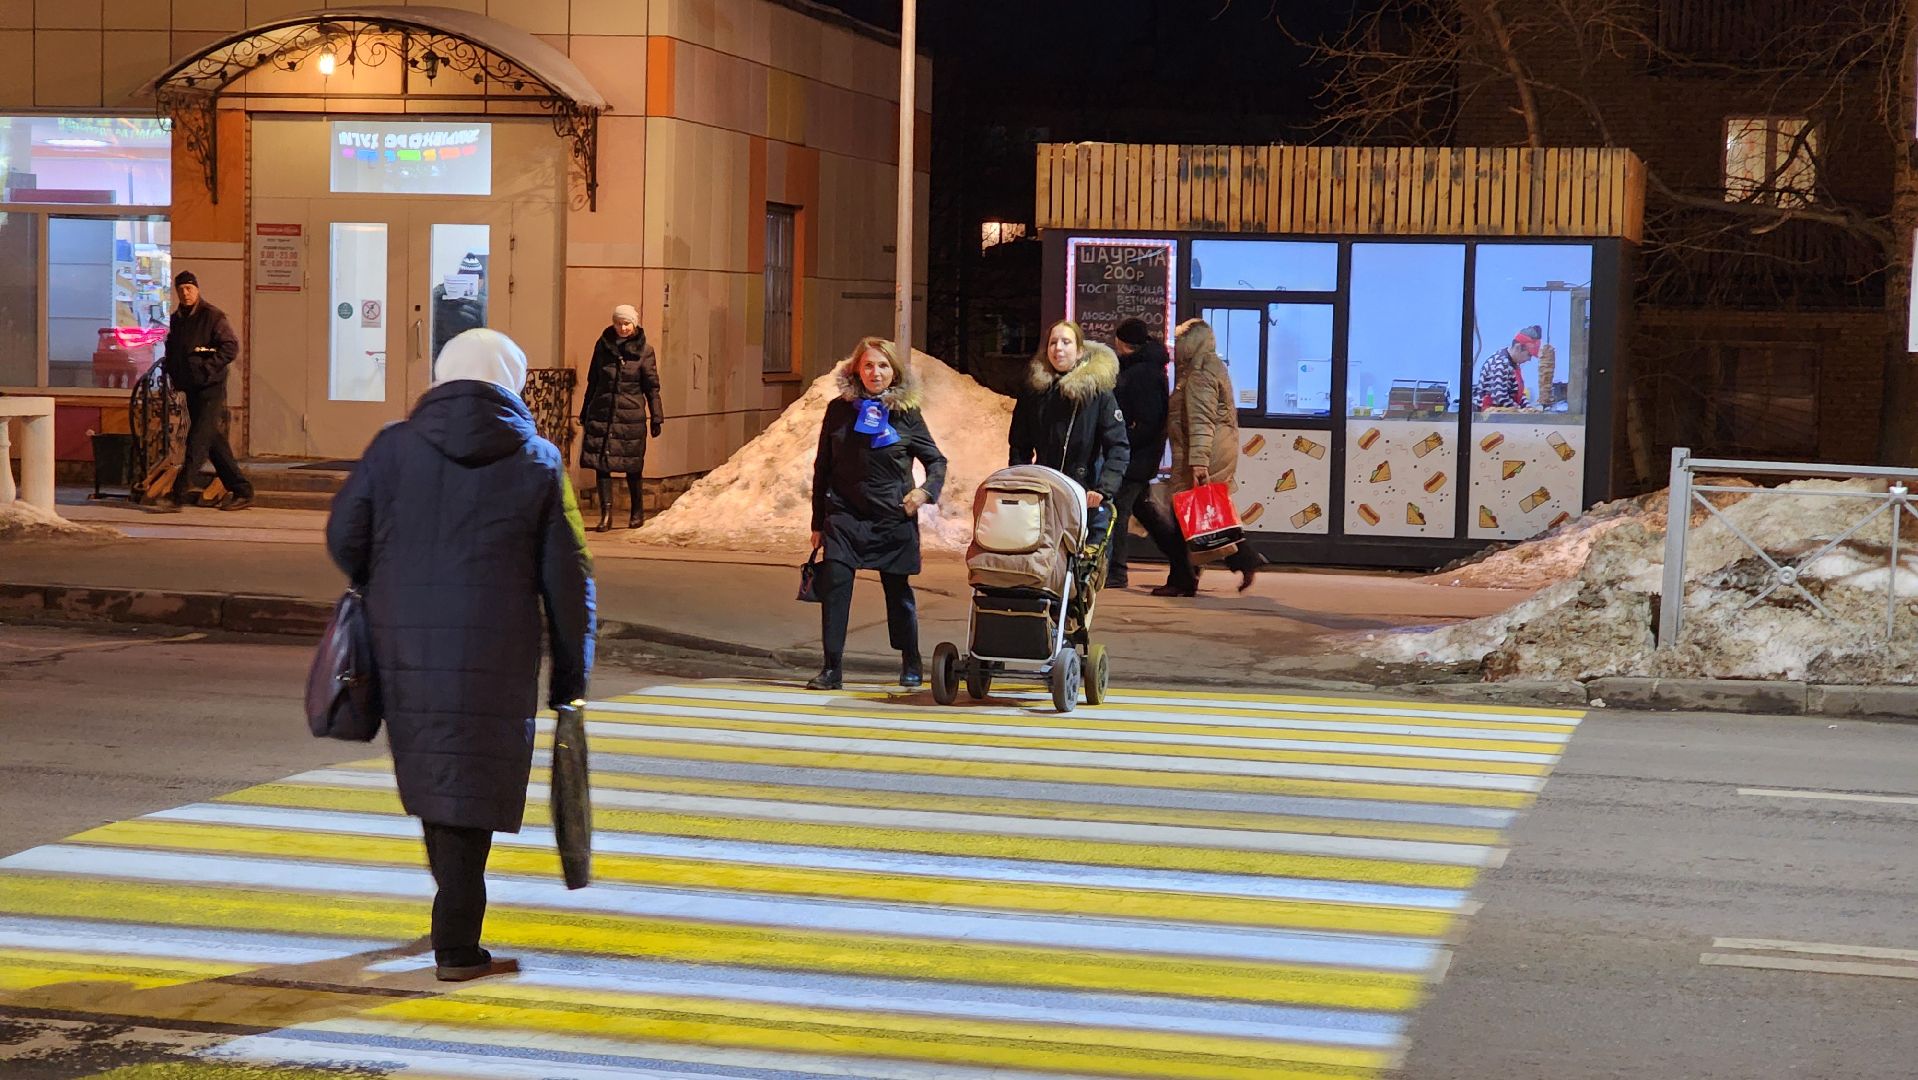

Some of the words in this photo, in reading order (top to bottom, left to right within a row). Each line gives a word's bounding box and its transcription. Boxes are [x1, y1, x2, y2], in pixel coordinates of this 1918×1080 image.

[1081, 248, 1166, 266] ШАУРМА
[1079, 284, 1109, 293] ТОСТ
[1117, 285, 1164, 295] КУРИЦА
[1117, 295, 1165, 305] ВЕТЧИНА
[1117, 305, 1145, 313] СЫР
[1082, 310, 1117, 320] ЛЮБОЙ
[1081, 323, 1114, 332] САМСА
